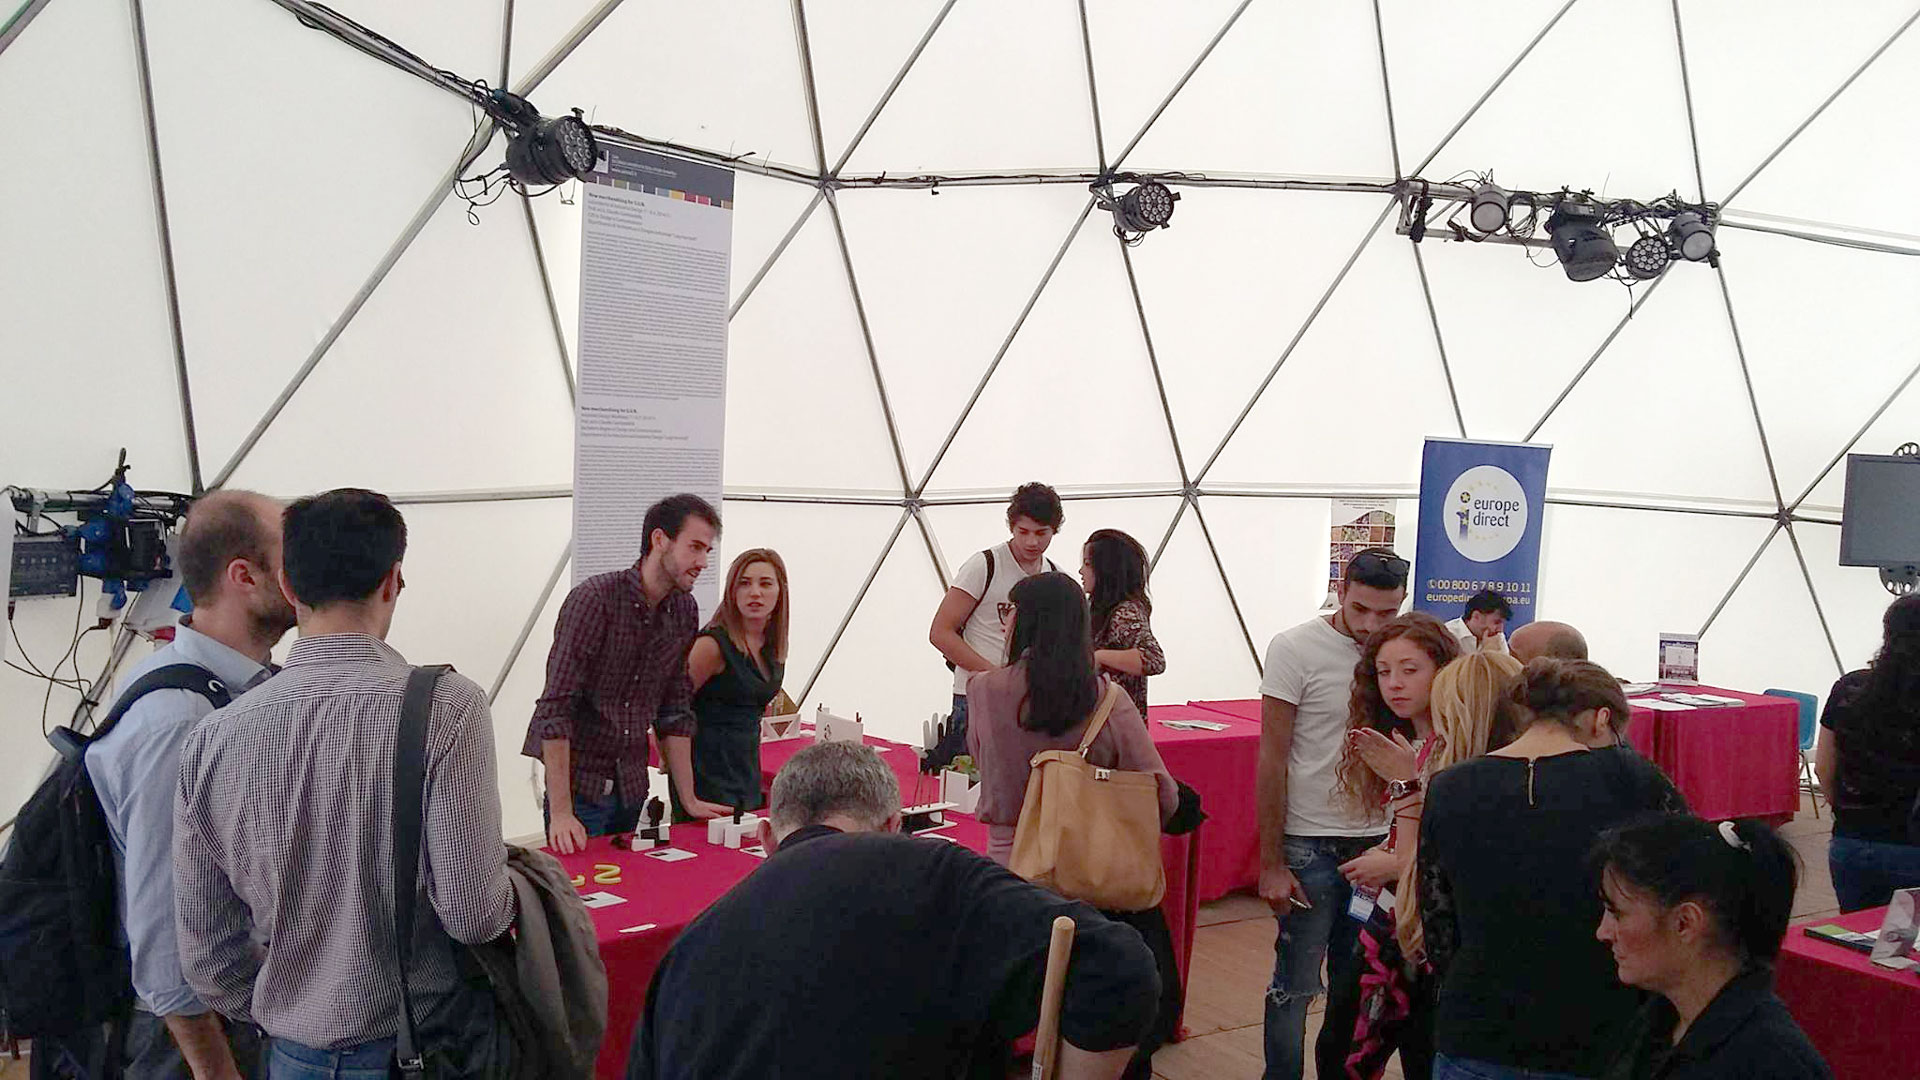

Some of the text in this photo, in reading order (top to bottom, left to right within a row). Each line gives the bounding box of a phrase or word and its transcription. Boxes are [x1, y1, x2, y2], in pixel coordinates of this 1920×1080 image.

[1474, 499, 1519, 515] europe
[1473, 511, 1509, 527] direct
[1437, 579, 1531, 593] 00 800 6 7 8 9 10 11
